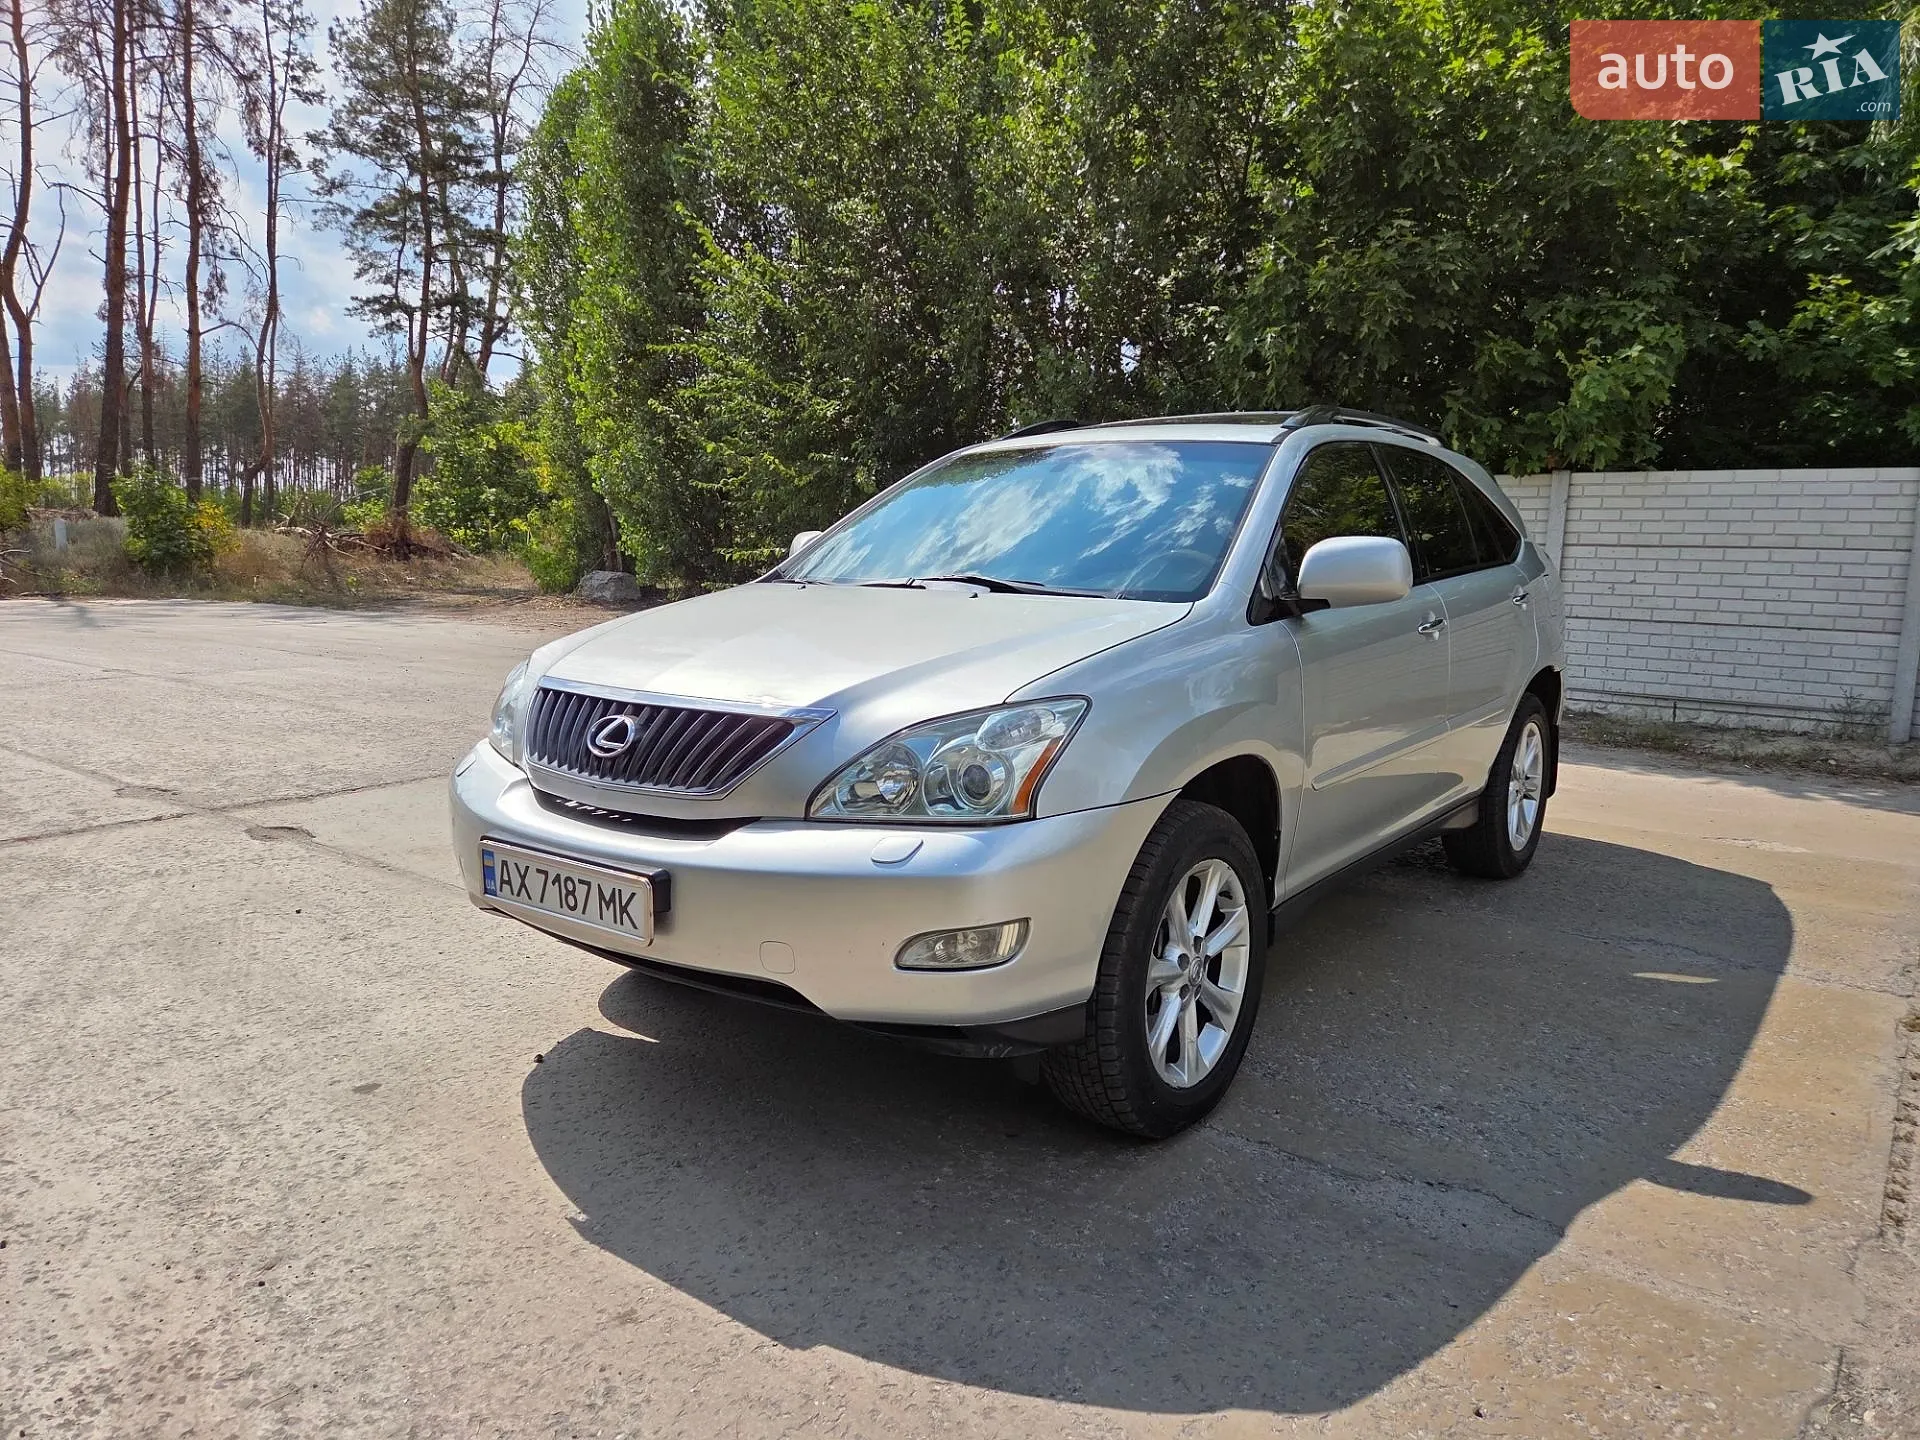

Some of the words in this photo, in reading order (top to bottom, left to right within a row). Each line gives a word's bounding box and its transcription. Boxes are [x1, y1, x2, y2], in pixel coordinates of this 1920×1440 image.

[486, 878, 496, 891] UA
[499, 859, 532, 901] AX
[535, 868, 592, 915] 7187
[597, 883, 639, 930] MK
